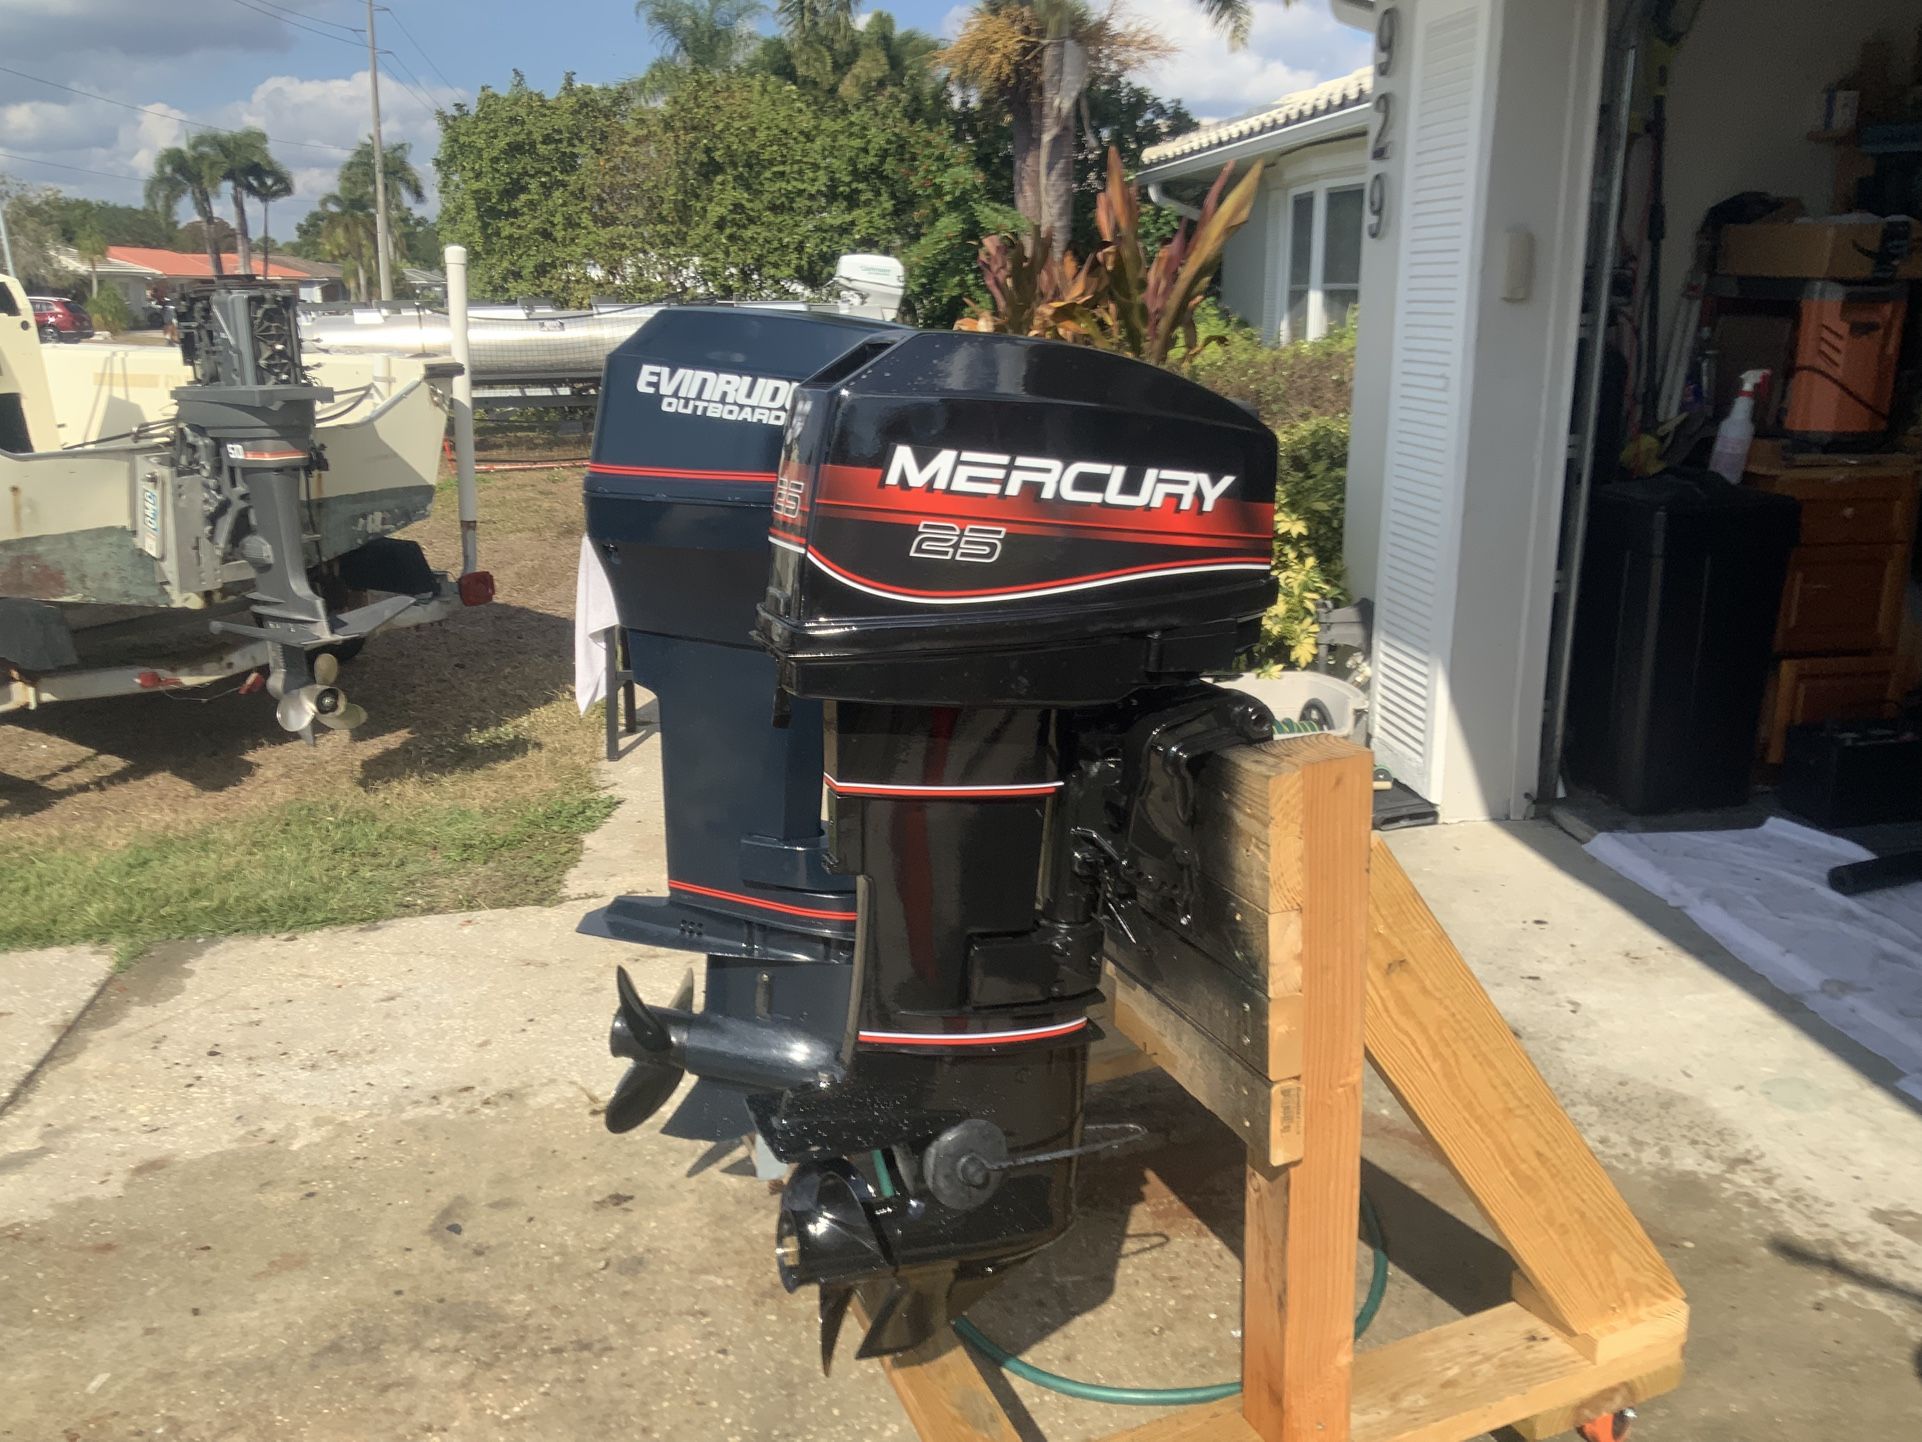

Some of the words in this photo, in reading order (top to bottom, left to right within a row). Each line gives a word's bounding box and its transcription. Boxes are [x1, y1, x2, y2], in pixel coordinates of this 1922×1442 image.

[661, 397, 787, 426] OUTBOARD
[884, 445, 1236, 513] MERCURY
[909, 520, 1007, 563] 25
